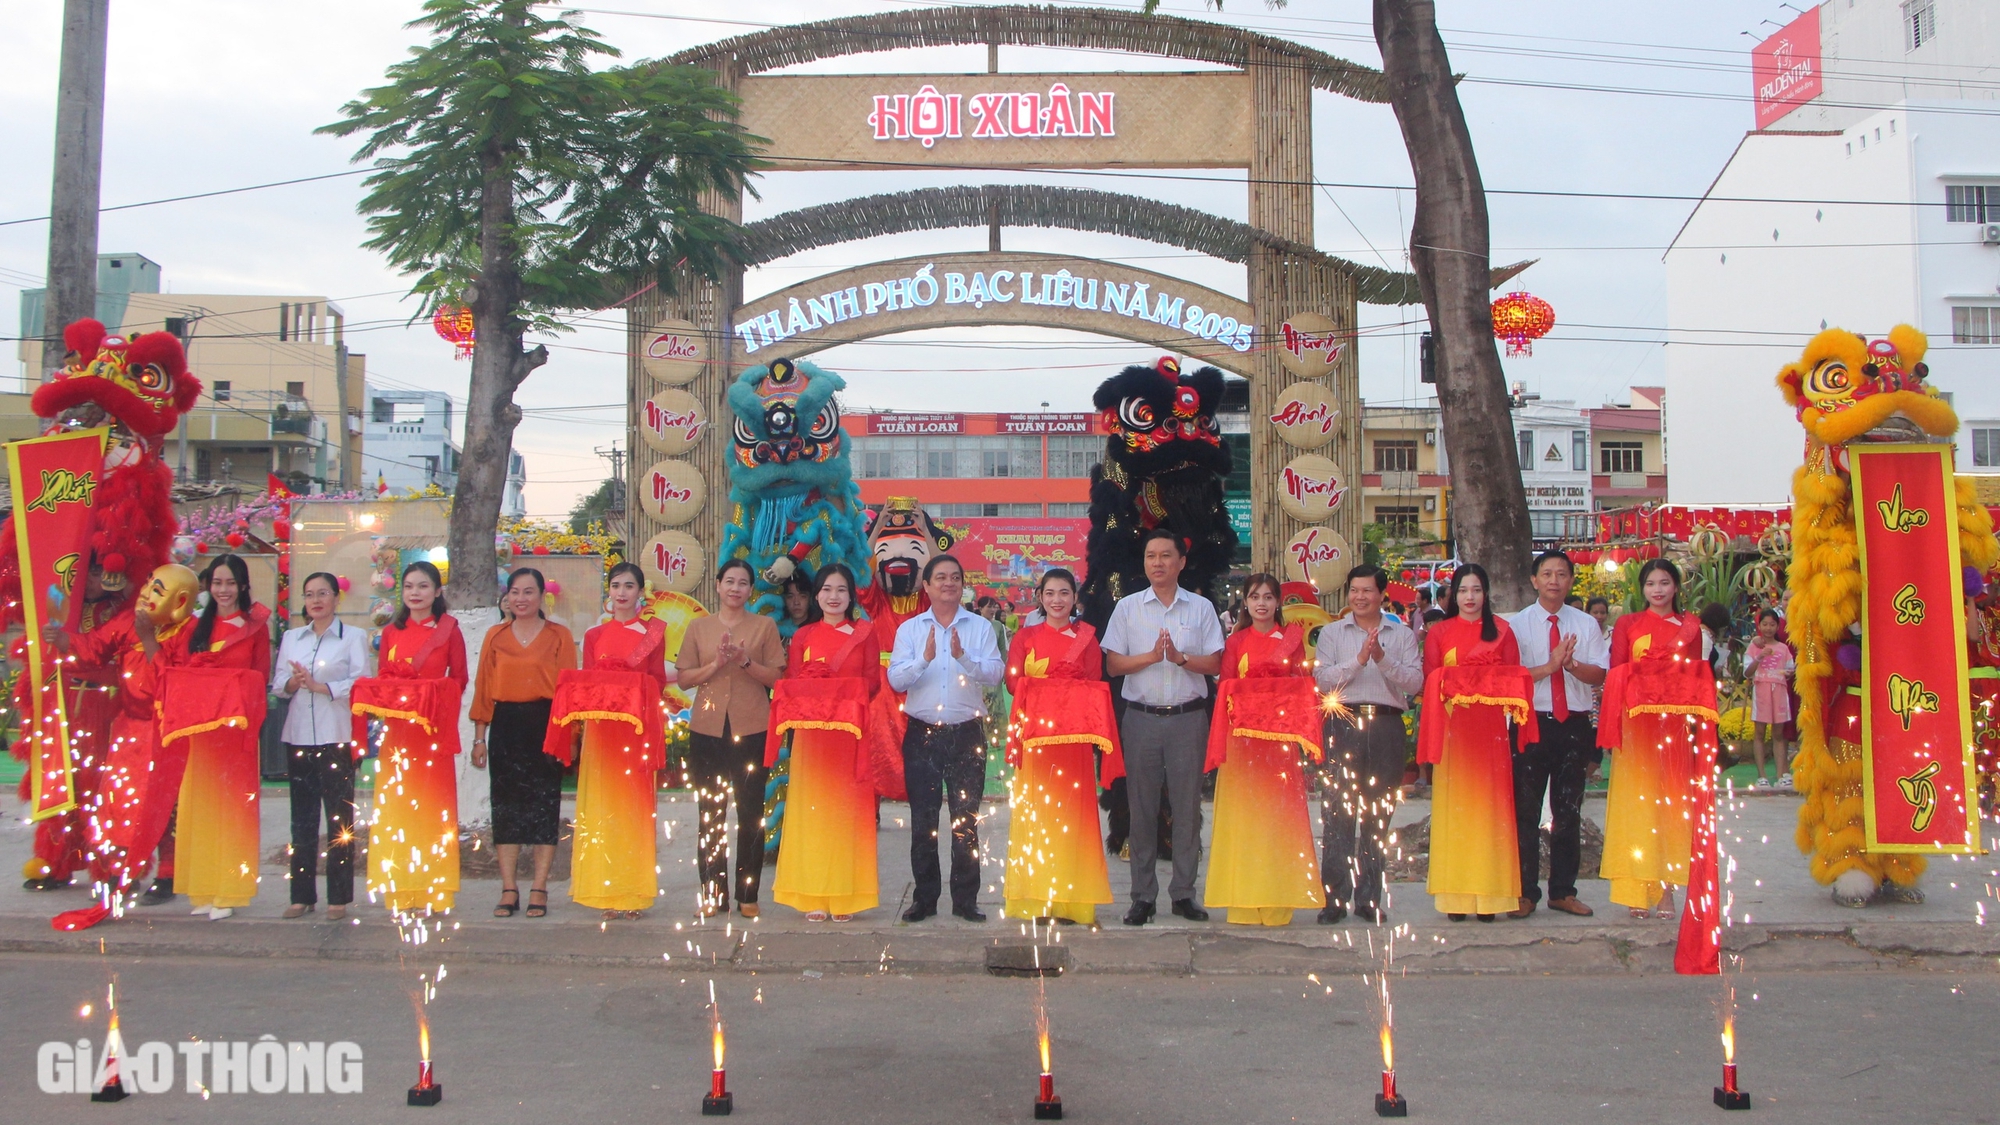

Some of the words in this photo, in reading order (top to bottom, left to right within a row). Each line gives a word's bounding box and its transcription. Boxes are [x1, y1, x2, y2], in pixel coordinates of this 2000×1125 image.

[1760, 58, 1813, 104] PRUDENTIAL
[868, 84, 962, 148] HỘI
[969, 83, 1115, 141] XUÂN
[735, 286, 860, 354] THÀNH
[863, 263, 939, 315] PHỐ
[945, 271, 1014, 309] BẠC
[1020, 268, 1098, 310] LIÊU
[1101, 281, 1185, 329] NĂM
[1182, 305, 1254, 352] 2025
[648, 333, 699, 359] Chúc
[1280, 322, 1346, 364] Mừng
[644, 400, 707, 441] Mừng
[877, 421, 916, 432] TUẤN
[919, 422, 958, 432] LOAN
[1006, 419, 1045, 432] TUẤN
[1048, 422, 1086, 432] LOAN
[652, 470, 692, 514] Năm
[1284, 467, 1348, 508] Mừng
[1567, 487, 1584, 496] KHOA
[1876, 482, 1930, 533] Vạn
[981, 544, 1012, 564] Hội
[1019, 544, 1081, 562] Xuân
[997, 534, 1030, 544] KHAI
[1032, 534, 1066, 546] MẠC
[654, 543, 688, 584] Mới
[1291, 529, 1340, 594] Xuân
[1892, 582, 1925, 626] Sự
[1886, 673, 1940, 730] Như
